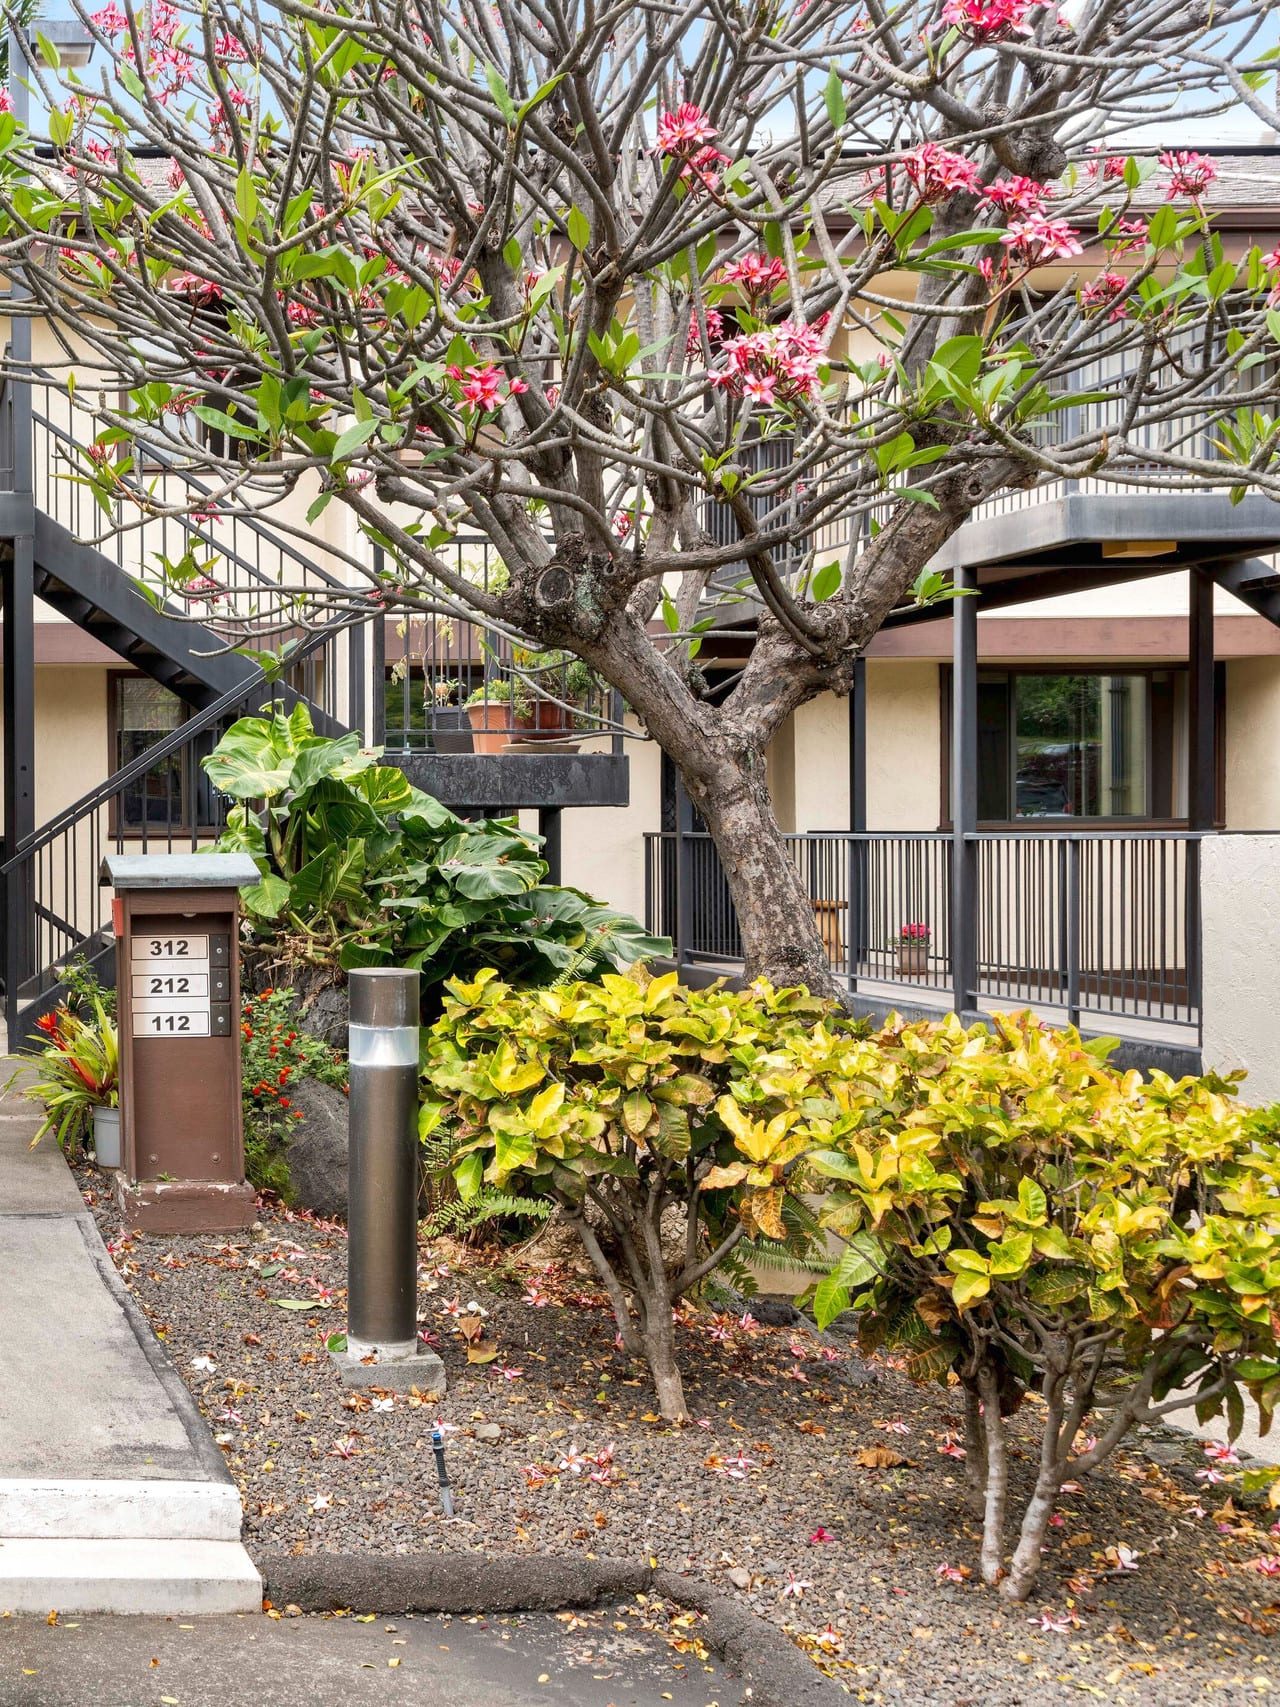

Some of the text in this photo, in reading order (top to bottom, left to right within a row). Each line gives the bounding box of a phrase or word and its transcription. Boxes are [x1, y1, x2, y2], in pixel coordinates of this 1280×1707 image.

[150, 940, 189, 956] 312
[150, 978, 190, 994] 212
[151, 1015, 190, 1031] 112
